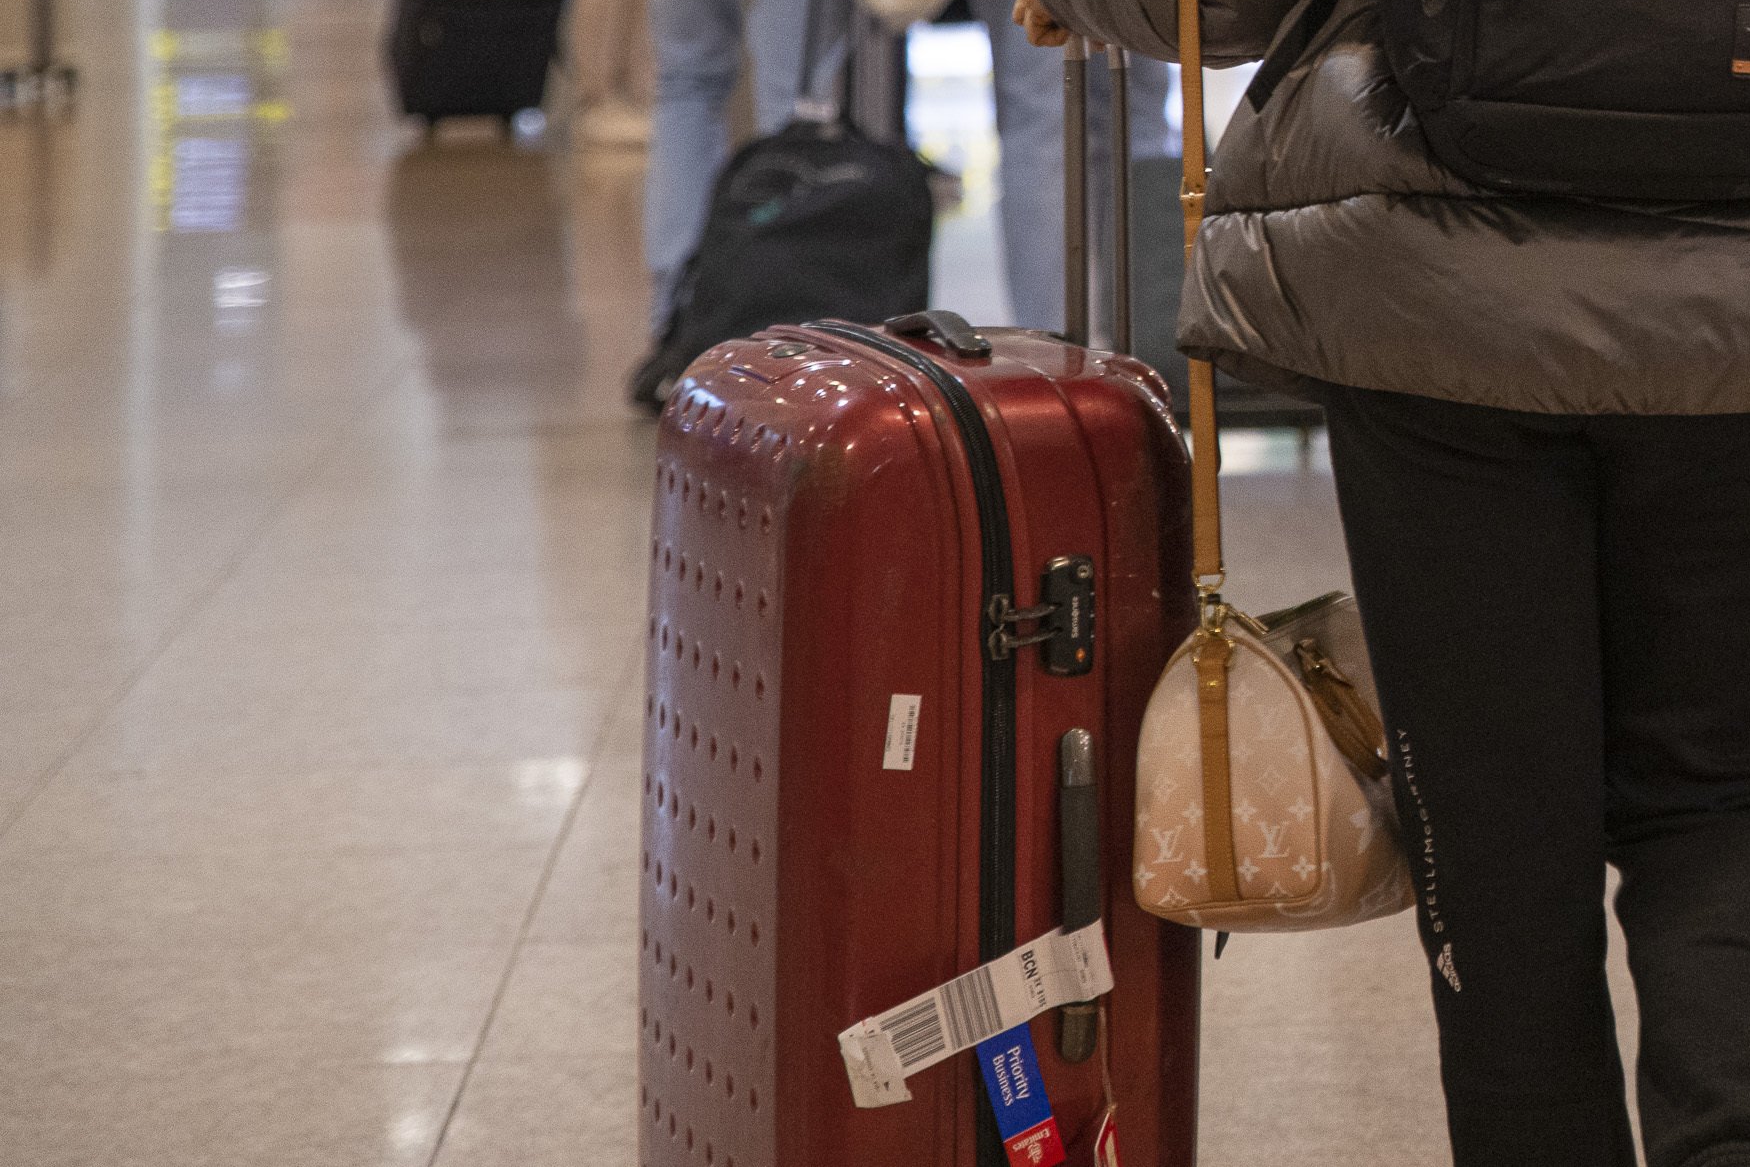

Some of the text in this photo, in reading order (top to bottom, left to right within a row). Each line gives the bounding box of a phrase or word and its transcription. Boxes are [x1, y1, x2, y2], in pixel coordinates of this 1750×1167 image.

[1071, 596, 1080, 639] Samsonite
[1021, 950, 1038, 980] BCN
[1442, 943, 1462, 992] adidas
[992, 1053, 1015, 1107] Business
[1007, 1044, 1031, 1100] Priority
[1012, 1127, 1051, 1152] Emirates
